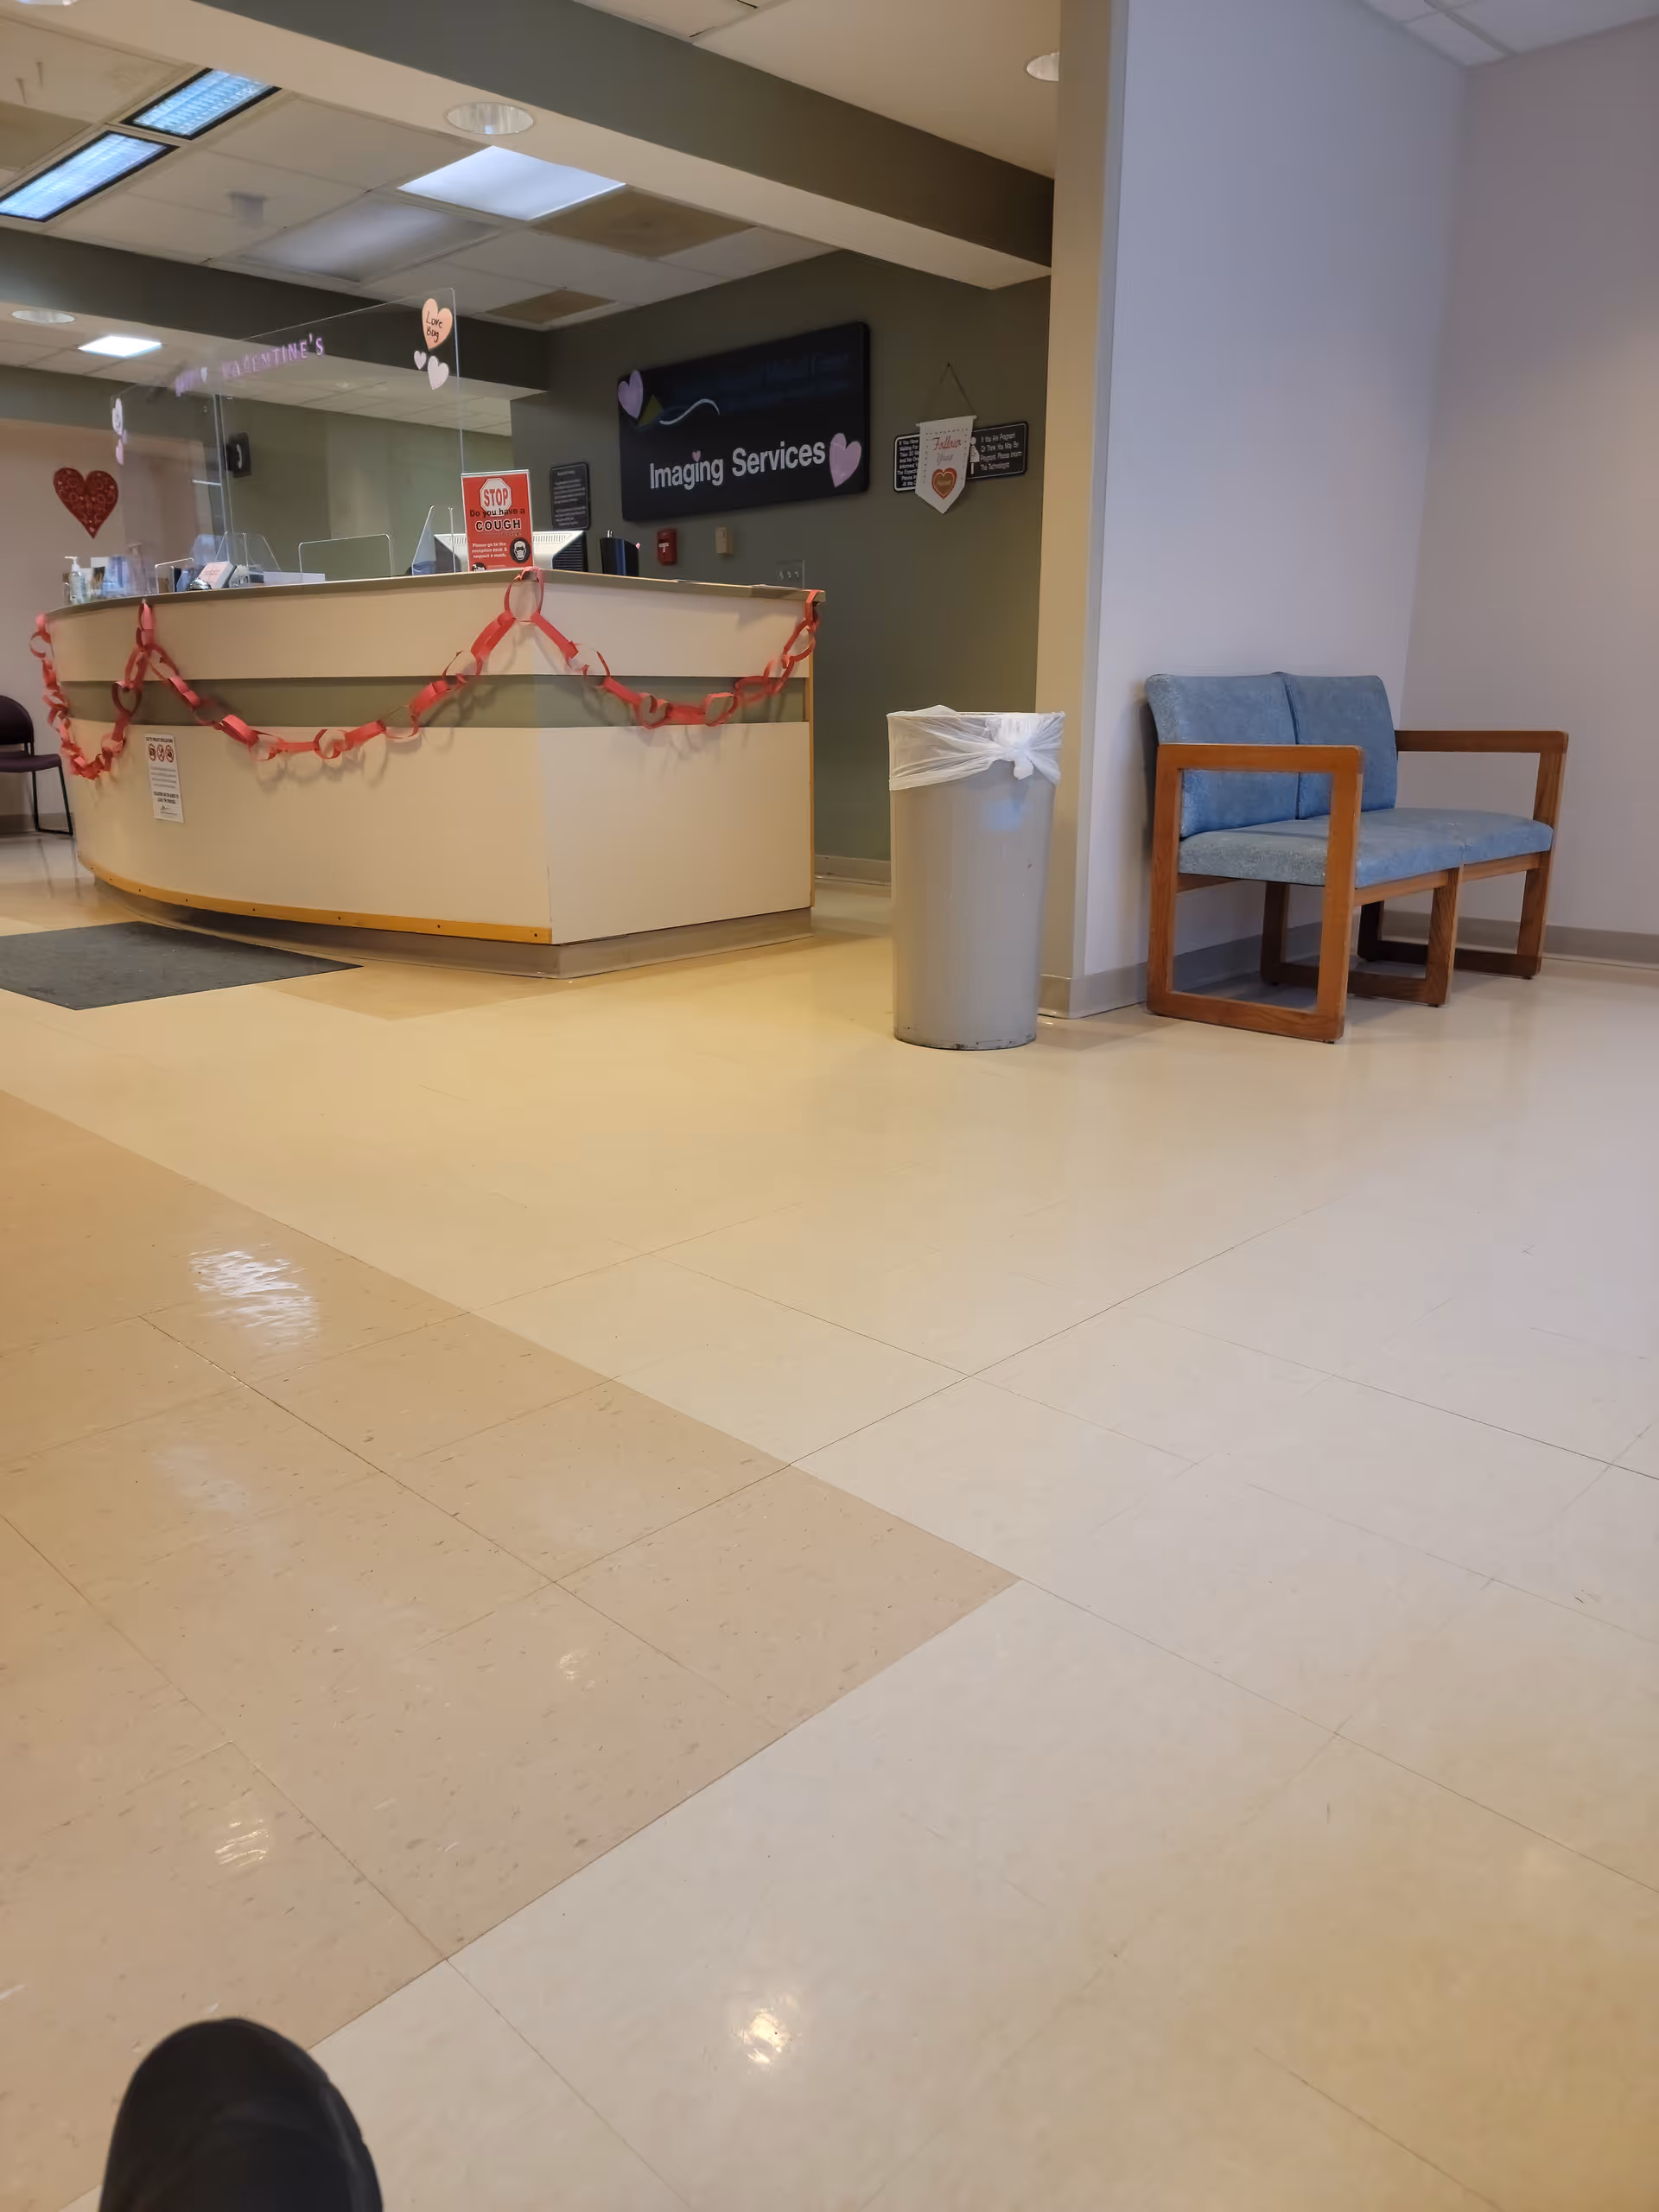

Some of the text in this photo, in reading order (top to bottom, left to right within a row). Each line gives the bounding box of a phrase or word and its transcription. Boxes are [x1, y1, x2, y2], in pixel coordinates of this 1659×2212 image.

[426, 311, 442, 328] Love
[426, 327, 439, 343] Bug
[933, 435, 962, 450] Follow
[650, 441, 826, 490] Imaging Services
[484, 487, 509, 507] STOP
[475, 518, 522, 532] COUGH
